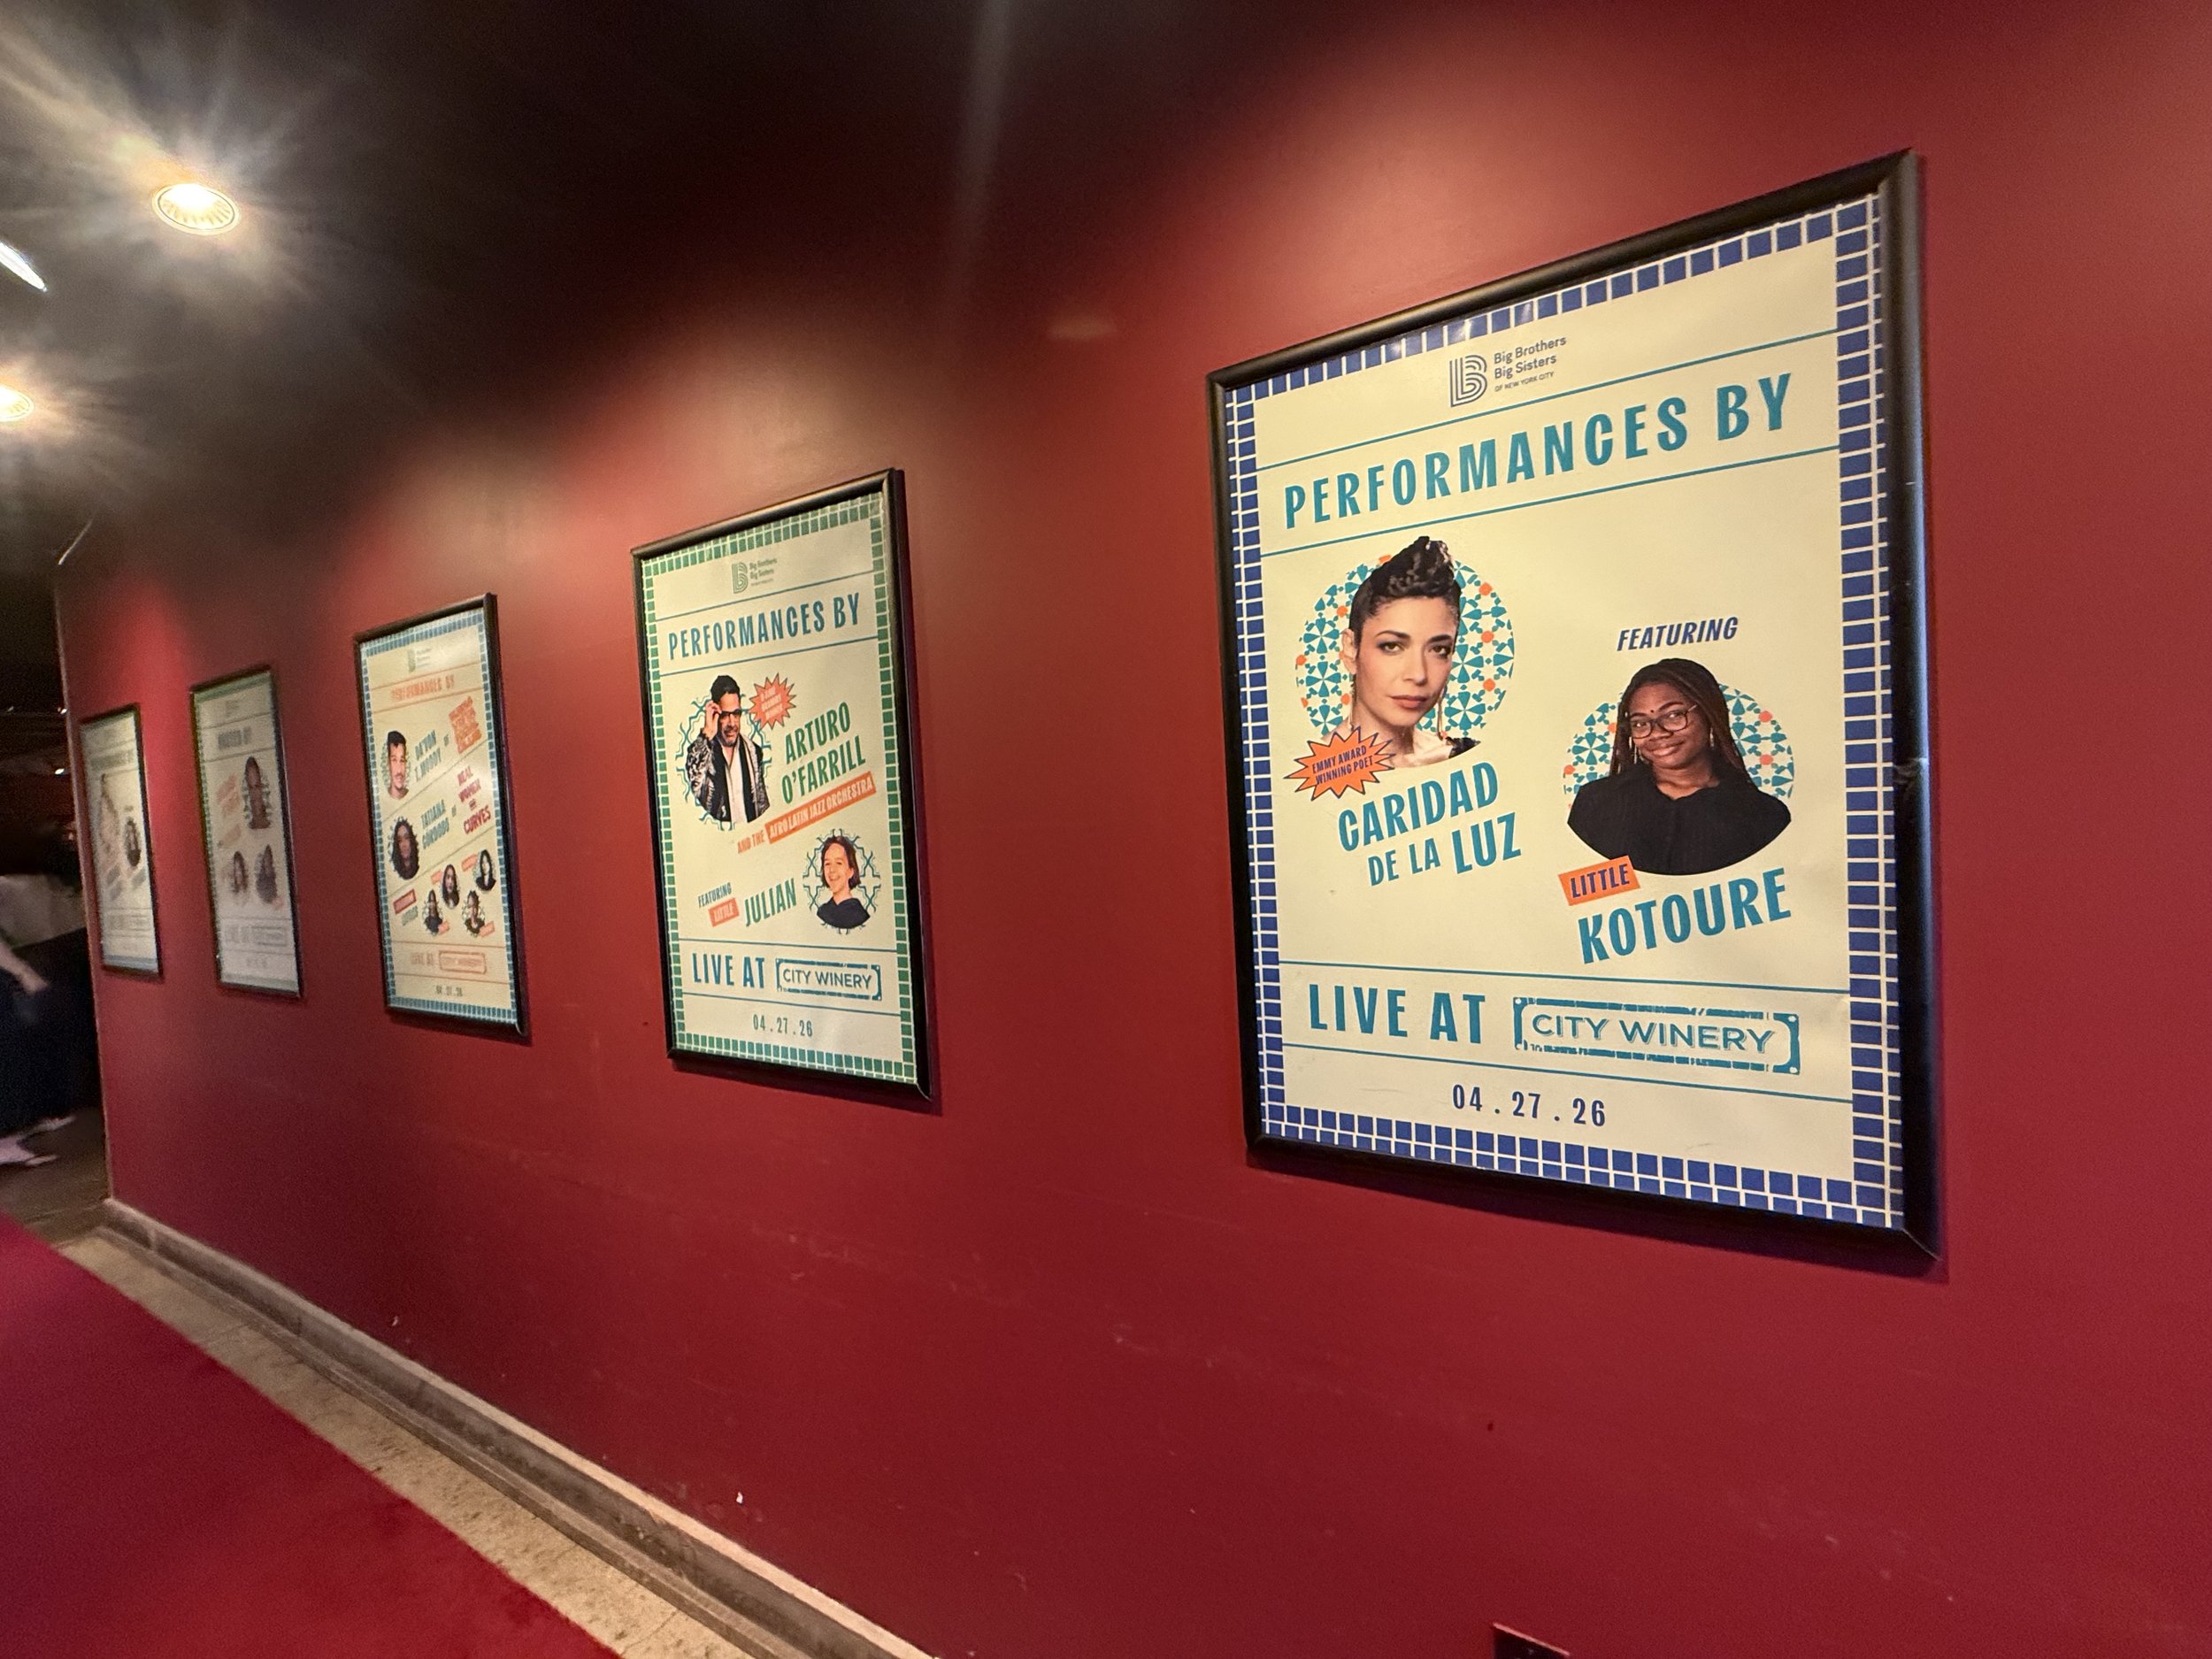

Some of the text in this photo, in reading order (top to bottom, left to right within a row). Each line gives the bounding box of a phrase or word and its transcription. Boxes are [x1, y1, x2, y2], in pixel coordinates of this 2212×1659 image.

[1494, 336, 1566, 365] Big Brothers
[1494, 355, 1557, 380] Big Sisters
[1504, 380, 1519, 390] NEW
[1521, 375, 1538, 385] YORK
[1539, 372, 1555, 380] CITY
[1285, 373, 1791, 528] PERFORMANCES BY
[669, 593, 860, 660] PERFORMANCES BY
[1617, 617, 1739, 651] FEATURING
[785, 702, 851, 765] ARTURO
[781, 735, 866, 804] O'FARRILL
[1312, 745, 1367, 773] EMMY AWARD
[1315, 756, 1373, 785] WINNING POET
[464, 805, 491, 834] CURVES
[737, 837, 751, 854] AND
[752, 830, 765, 848] THE
[809, 799, 826, 818] JAZZ
[826, 777, 873, 810] ORCHESTRA
[1339, 762, 1498, 851] CARIDAD
[1368, 811, 1522, 886] DE LA LUZ
[698, 882, 732, 908] FEATURING
[1571, 864, 1630, 899] LITTLE
[745, 878, 796, 927] JULIAN
[1578, 867, 1792, 964] KOTOURE
[693, 953, 764, 988] LIVE AT
[783, 968, 872, 989] CITY WINERY
[1310, 984, 1486, 1044] LIVE AT
[1532, 1014, 1775, 1053] CITY WINERY
